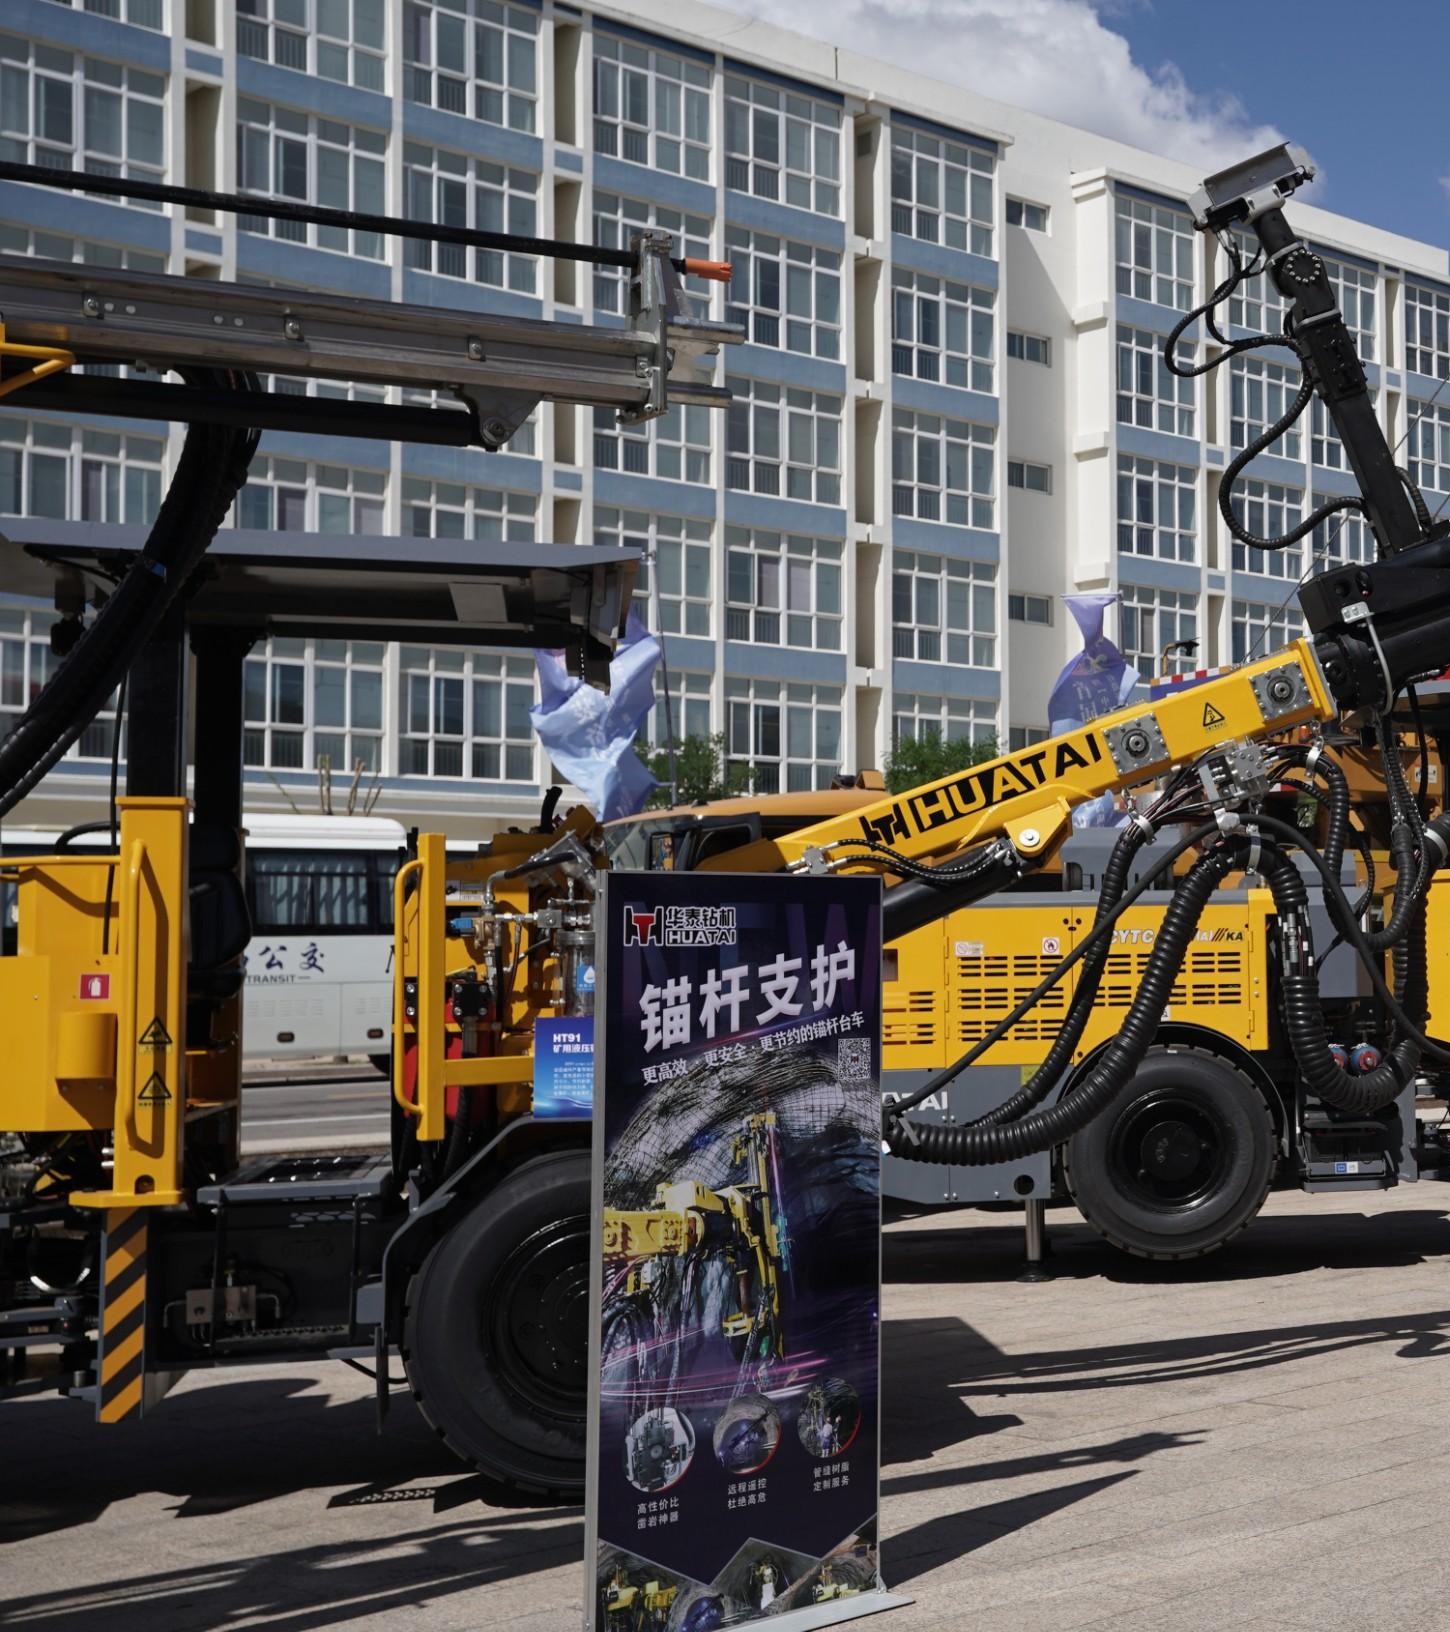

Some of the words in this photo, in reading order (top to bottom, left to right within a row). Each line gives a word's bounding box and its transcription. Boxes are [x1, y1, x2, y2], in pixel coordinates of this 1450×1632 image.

[908, 733, 1102, 833] HUATAI
[666, 906, 737, 929] 华泰钻机
[666, 929, 737, 946] HUATAI
[244, 942, 325, 973] 公交
[247, 975, 296, 984] TRANSIT
[639, 940, 856, 1053] 锚杆支护
[553, 1033, 581, 1043] HT91
[637, 1496, 679, 1515] 高性价比
